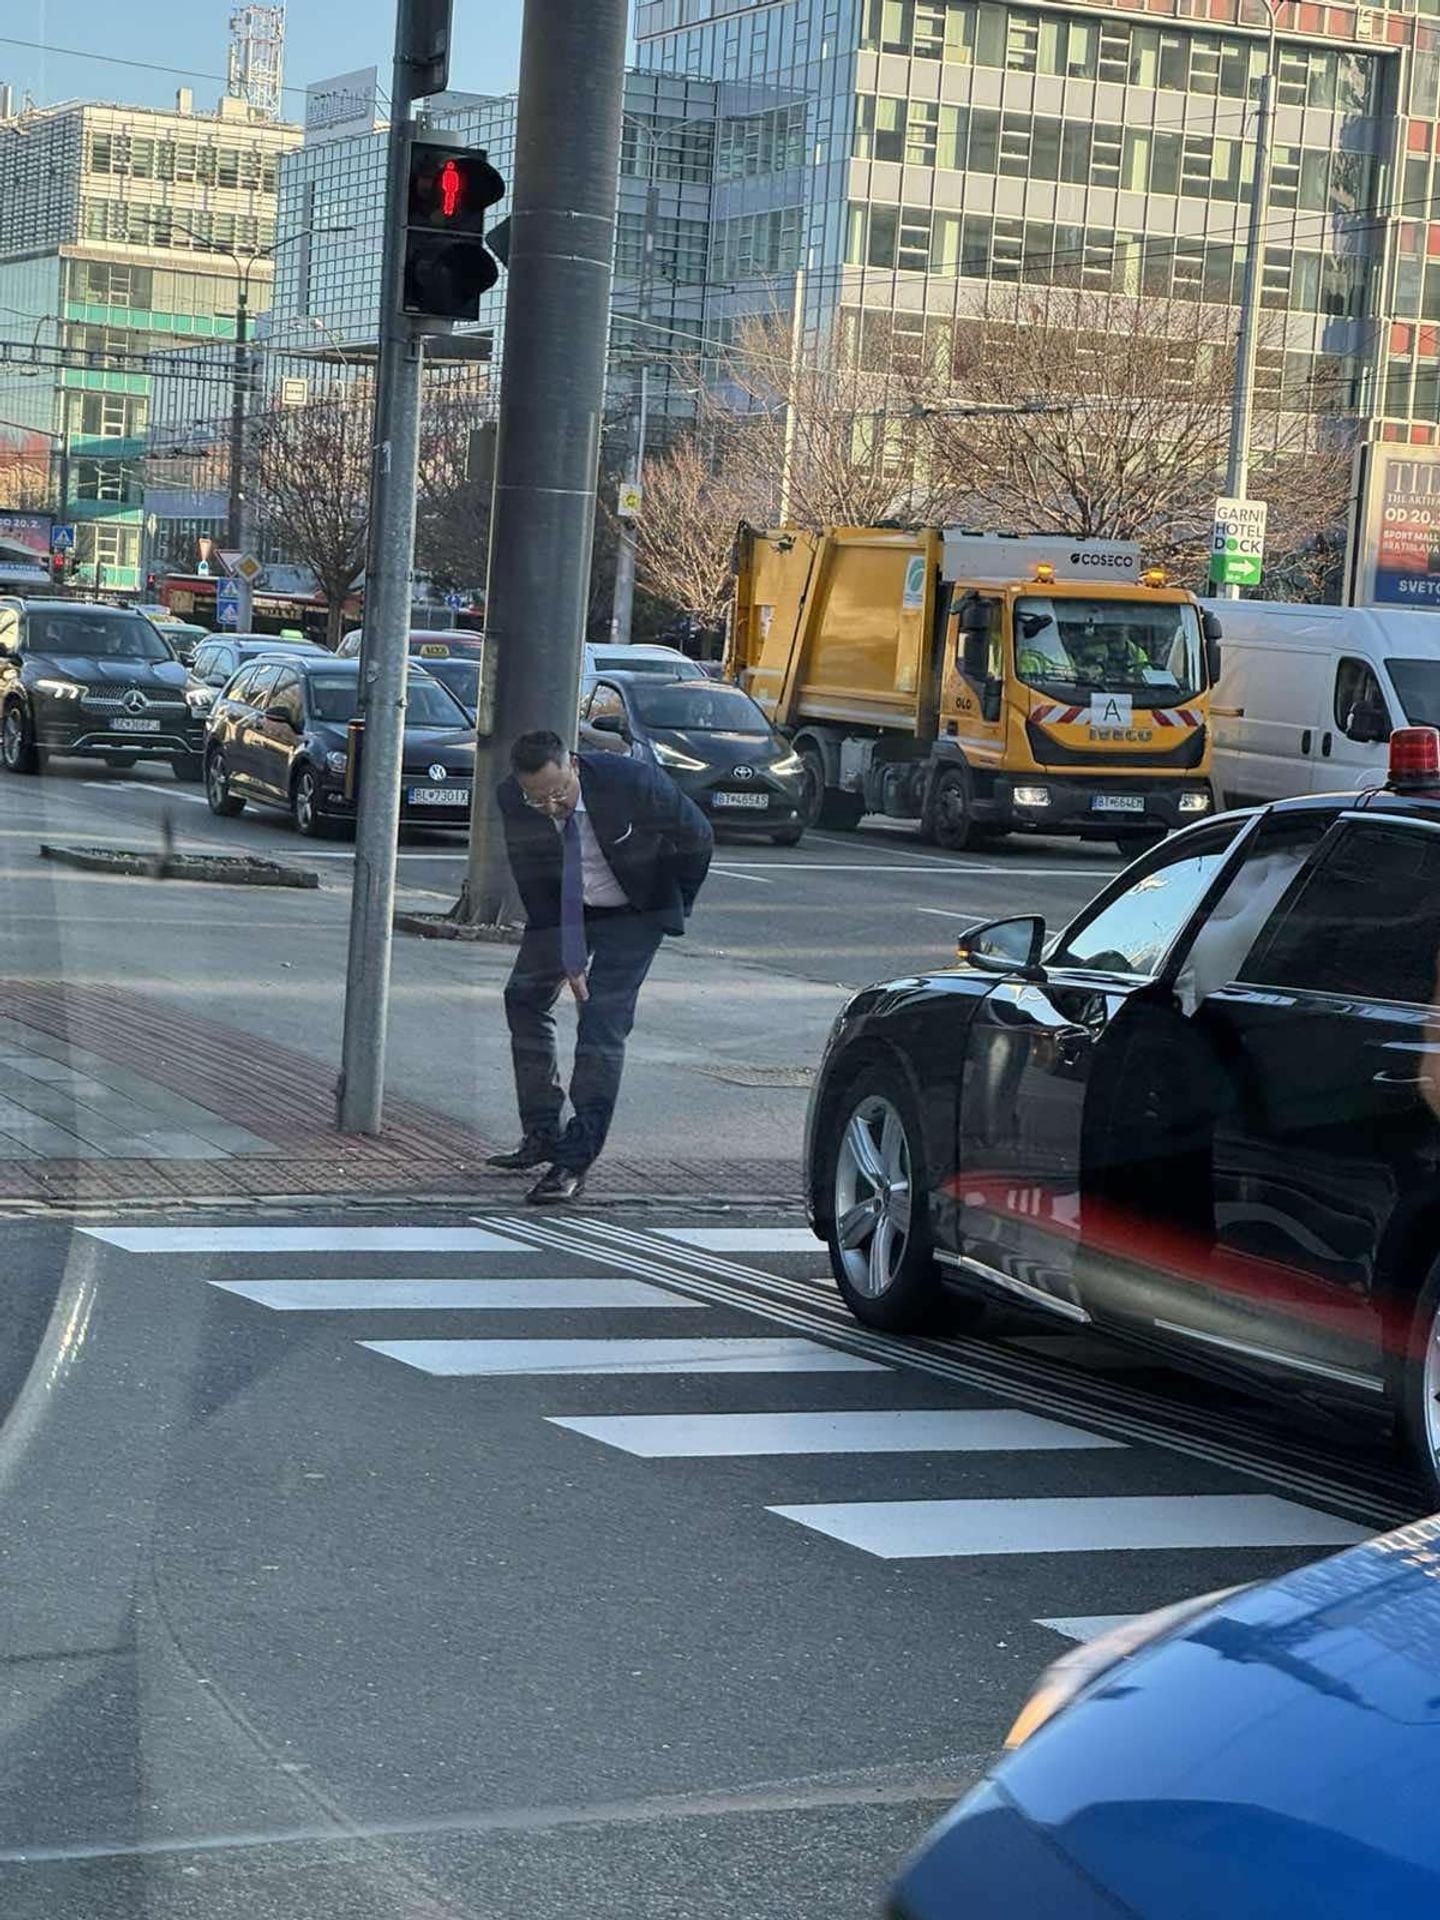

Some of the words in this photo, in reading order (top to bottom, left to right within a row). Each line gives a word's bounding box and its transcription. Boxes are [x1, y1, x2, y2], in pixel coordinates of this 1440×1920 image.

[1217, 506, 1264, 523] GARNI
[1385, 508, 1407, 522] OD
[1216, 521, 1263, 538] HOTEL
[1414, 531, 1440, 543] MALL
[1215, 537, 1261, 553] DOCK
[1081, 553, 1133, 567] COSECO
[1104, 699, 1122, 721] A
